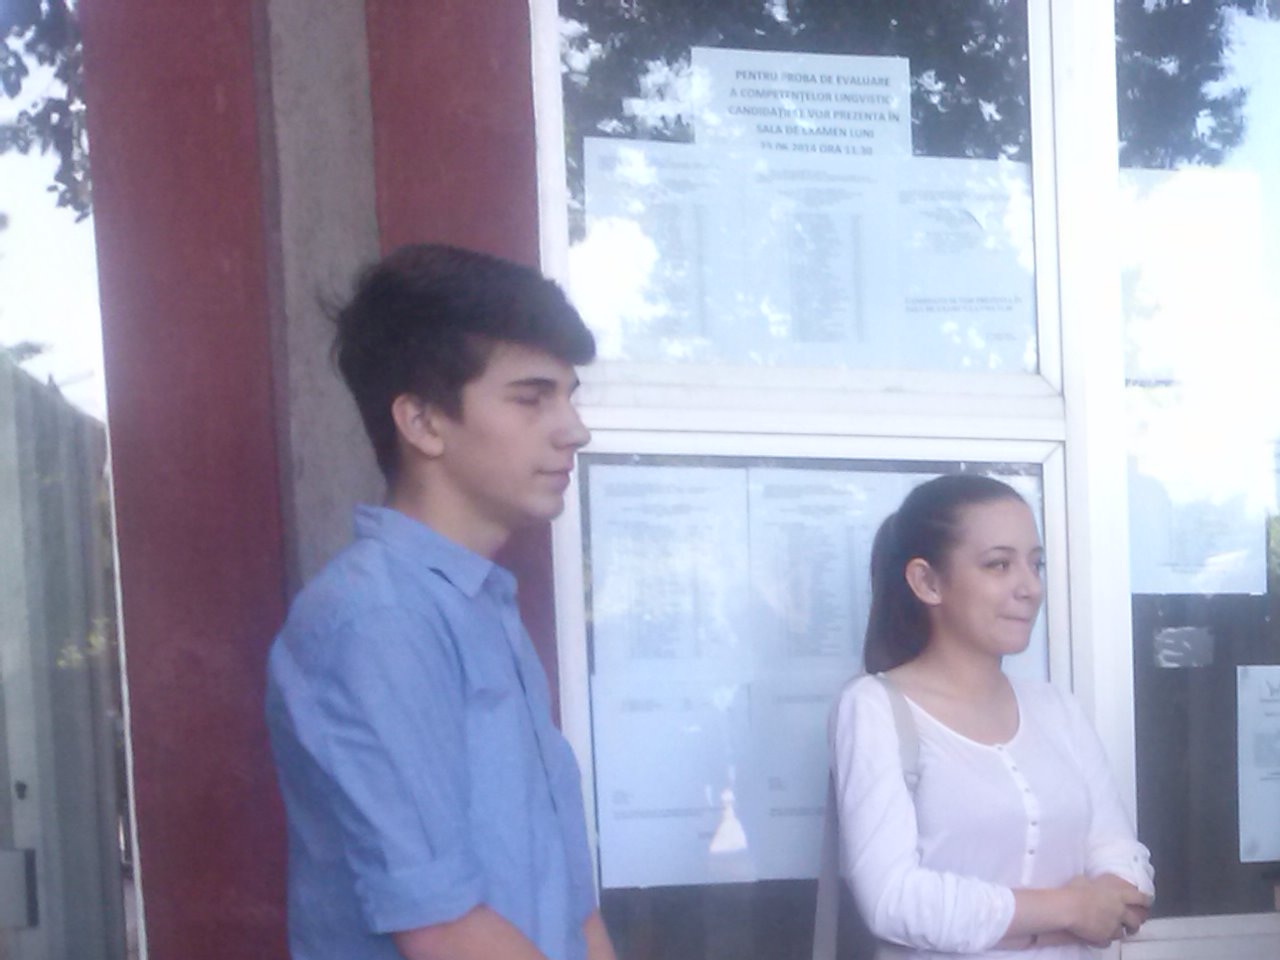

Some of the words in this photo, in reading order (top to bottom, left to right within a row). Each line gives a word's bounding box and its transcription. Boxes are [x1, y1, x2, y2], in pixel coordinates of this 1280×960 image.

[735, 70, 778, 82] PENTRU
[781, 72, 818, 85] PROBA
[820, 74, 833, 85] DE
[836, 74, 891, 87] EVALUARE
[729, 88, 738, 98] A
[835, 92, 895, 105] LINGVISTIC
[807, 109, 831, 120] VOR
[833, 110, 886, 122] PREZENTA
[756, 124, 783, 135] SALA
[785, 125, 799, 136] DE
[802, 126, 847, 138] EXAMEN
[849, 128, 875, 139] LUNI
[819, 143, 842, 155] ORA
